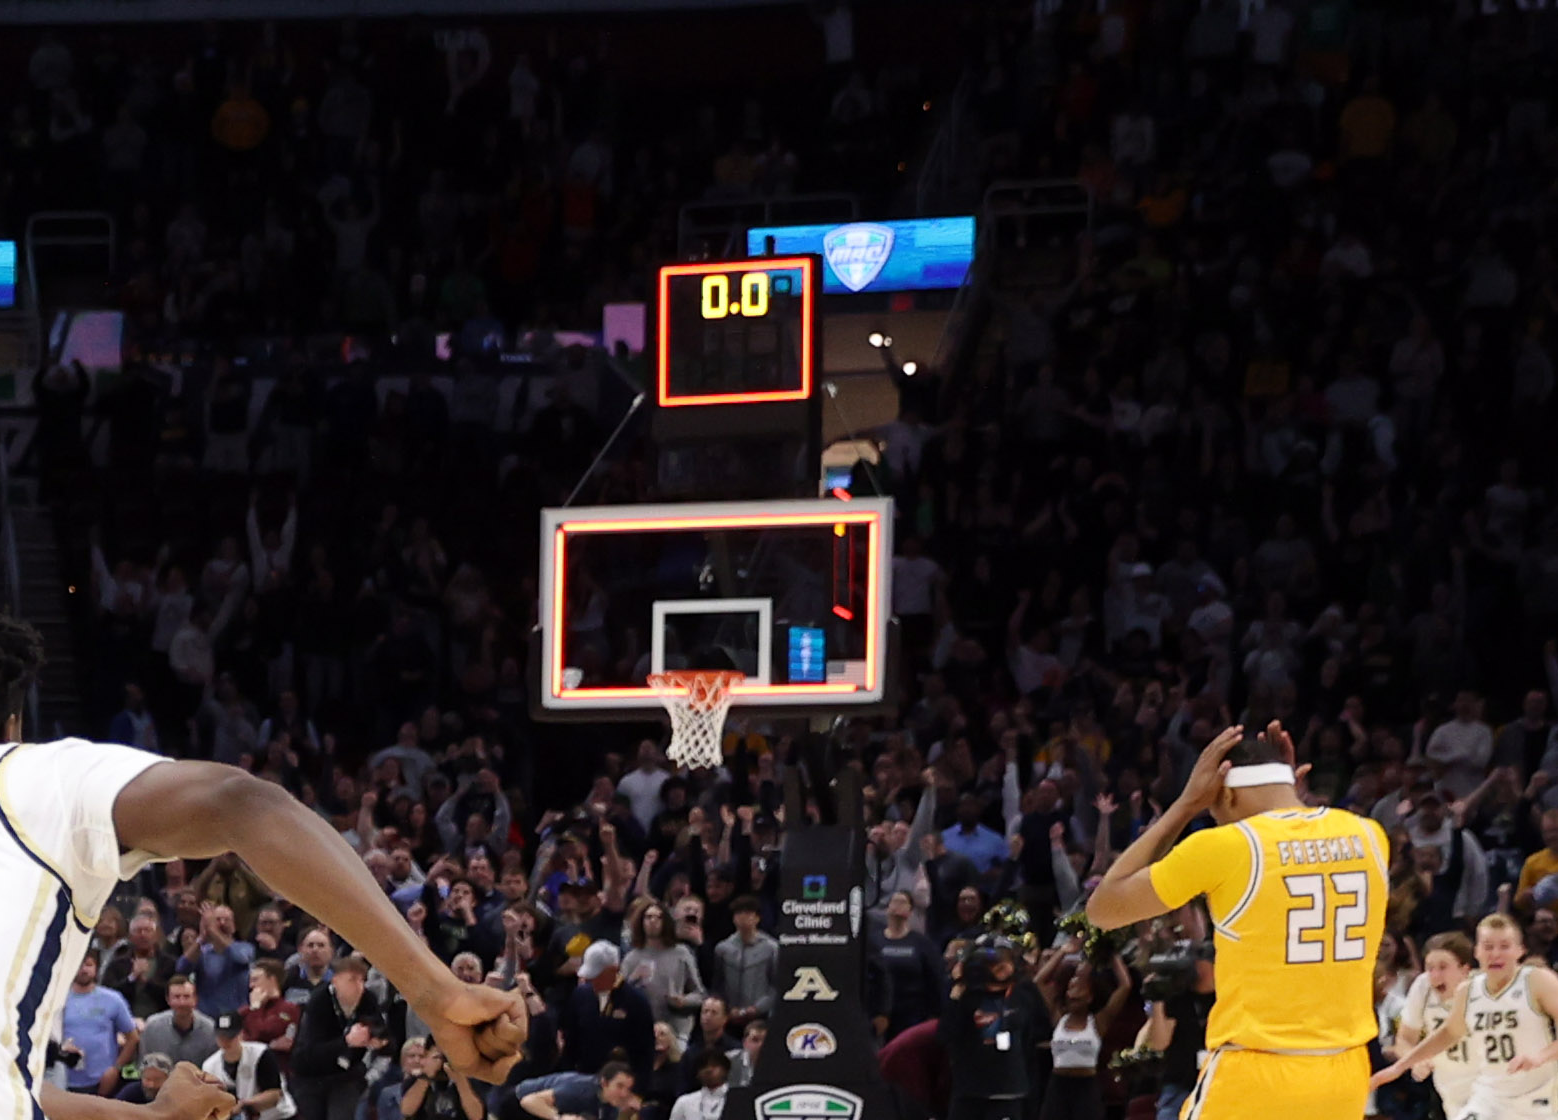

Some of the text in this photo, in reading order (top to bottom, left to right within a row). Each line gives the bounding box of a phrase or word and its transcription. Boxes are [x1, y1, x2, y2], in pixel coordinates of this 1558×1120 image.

[701, 272, 769, 320] 0.0
[1277, 835, 1365, 866] FREEMAN
[782, 899, 847, 915] Cleveland
[794, 914, 833, 929] Clinic
[1282, 870, 1369, 965] 22
[783, 966, 840, 1001] A
[1473, 1009, 1519, 1032] ZIPS
[1484, 1033, 1517, 1064] 20
